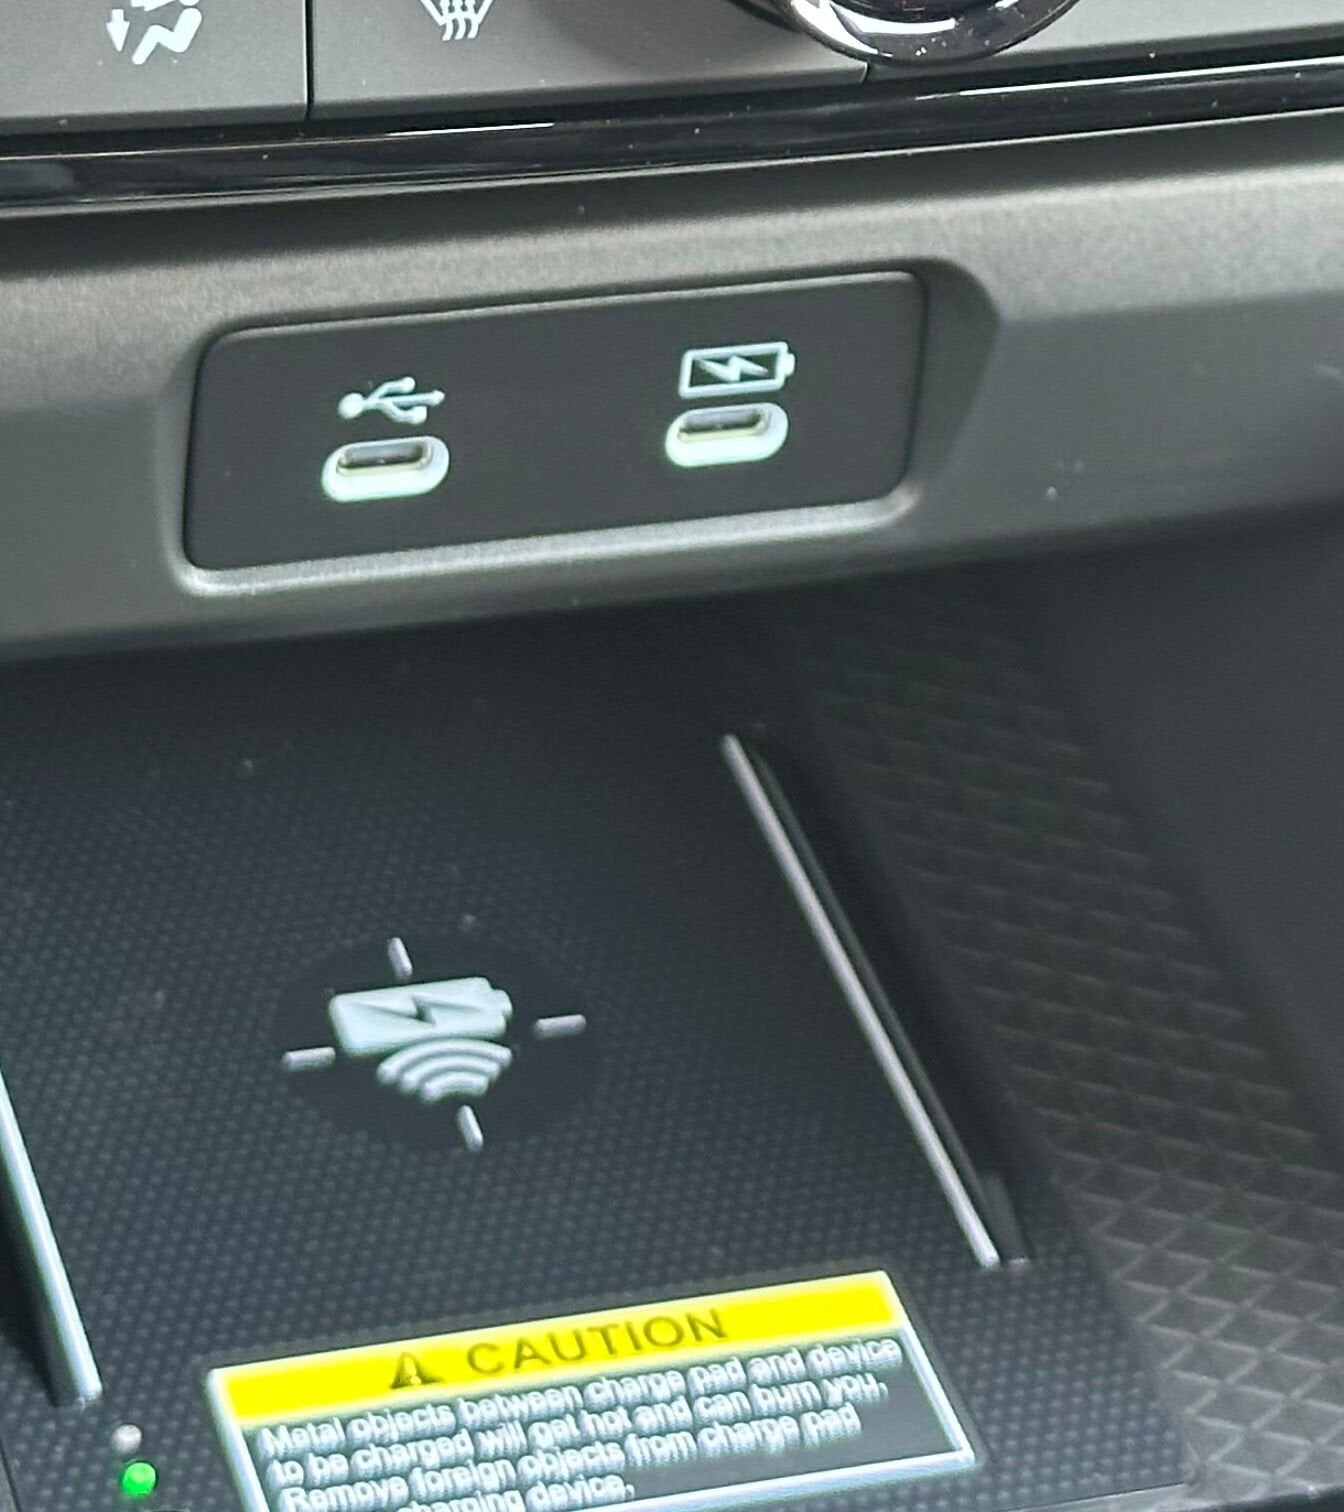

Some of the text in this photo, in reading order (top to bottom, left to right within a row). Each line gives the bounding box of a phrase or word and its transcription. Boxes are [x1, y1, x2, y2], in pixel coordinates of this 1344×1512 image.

[466, 1308, 729, 1376] CAUTION
[258, 1339, 903, 1459] Metal objects between charge pad and device
[265, 1459, 304, 1488] to
[304, 1452, 349, 1486] be
[350, 1428, 475, 1478] charged
[474, 1420, 527, 1460] will
[528, 1415, 581, 1451] get
[579, 1406, 632, 1443] hot
[632, 1395, 693, 1434] and
[693, 1391, 752, 1427] can
[750, 1381, 822, 1416] burn
[279, 1401, 862, 1512] Remove foreign objects from charge pad
